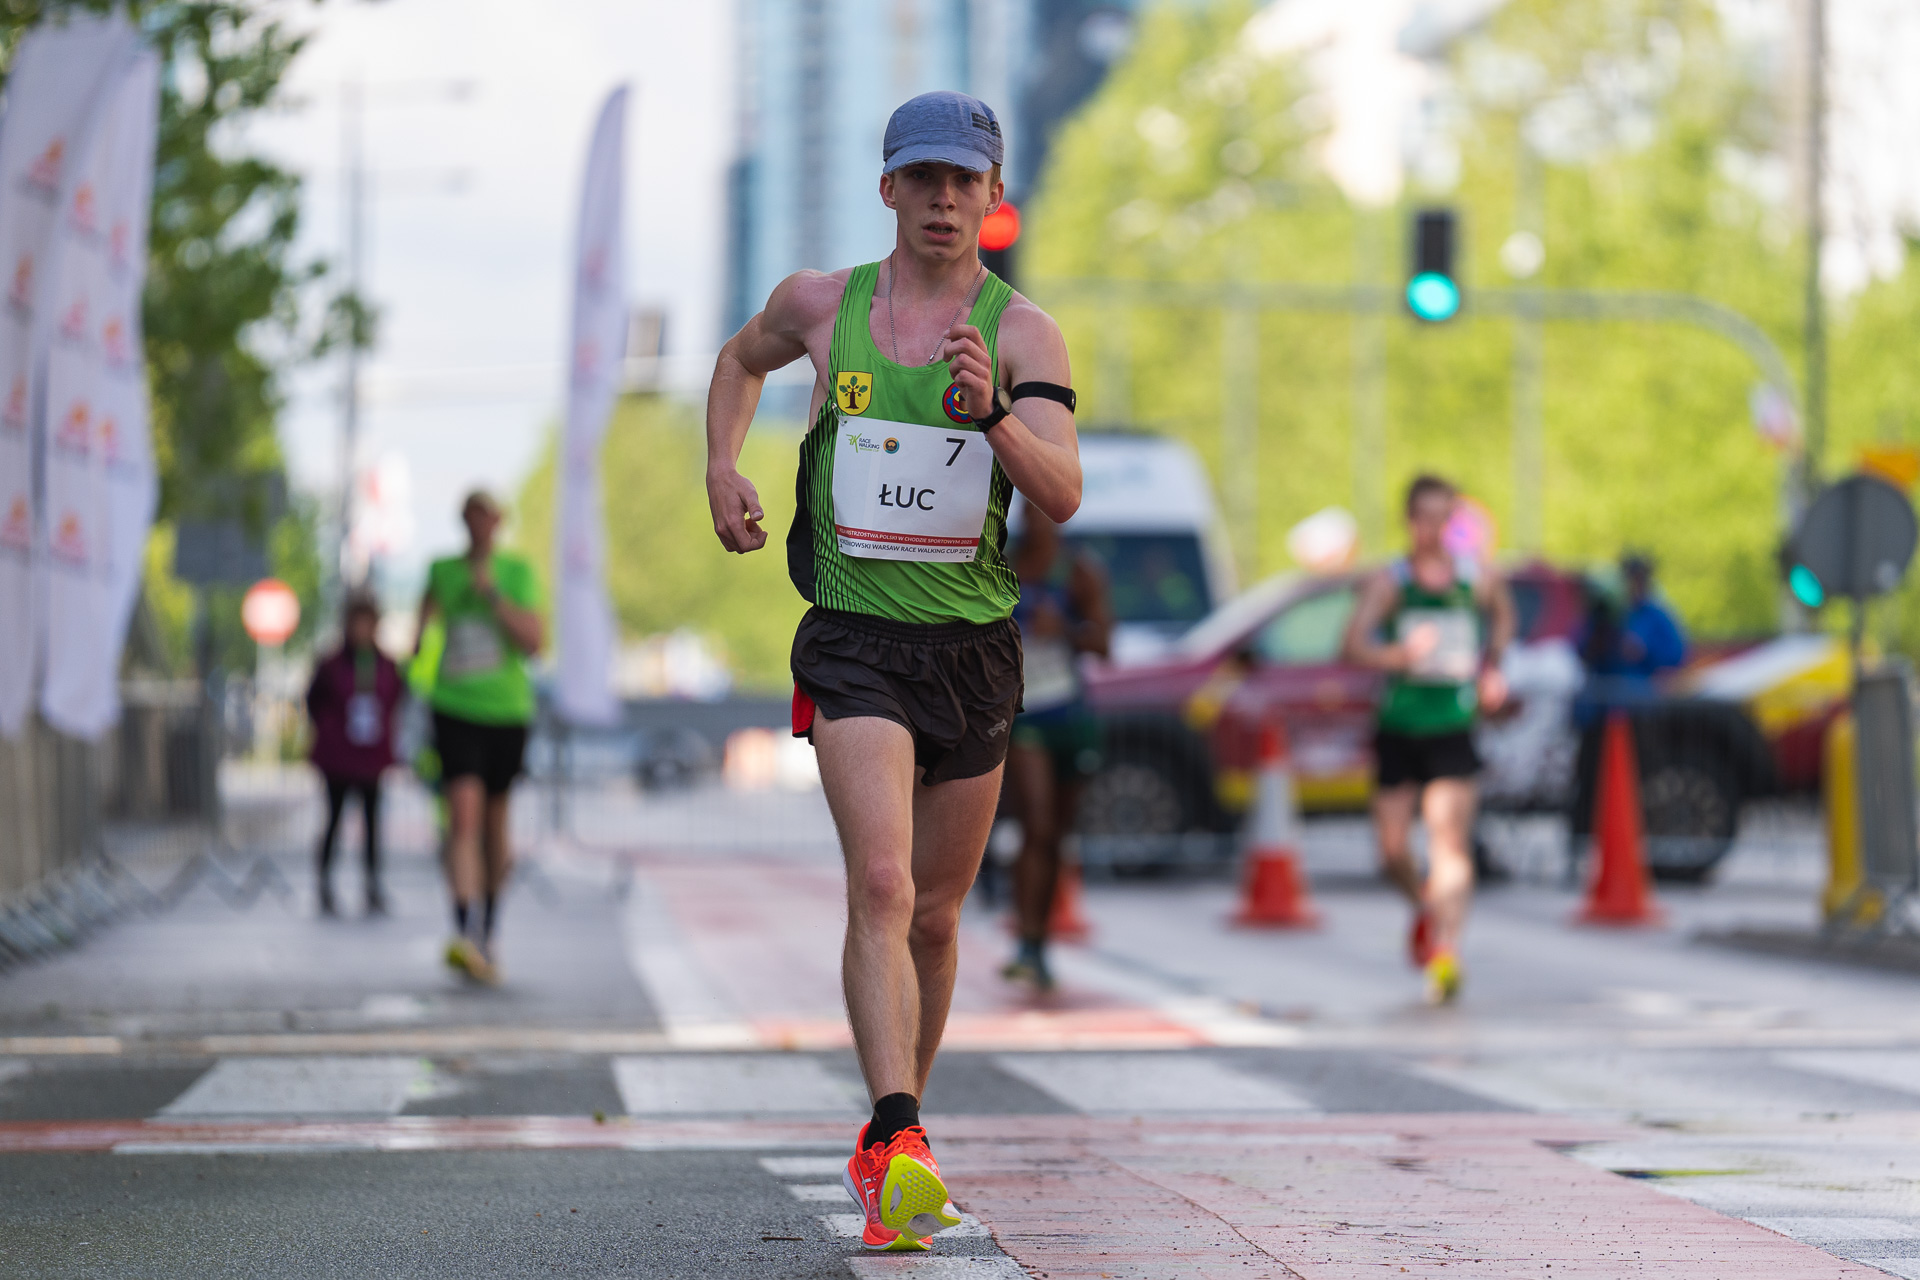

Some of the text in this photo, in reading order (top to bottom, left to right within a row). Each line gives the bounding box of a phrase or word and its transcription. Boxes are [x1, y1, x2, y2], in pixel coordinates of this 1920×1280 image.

[945, 437, 966, 467] 7
[878, 483, 936, 511] ŁUC
[872, 544, 900, 552] WARSAW
